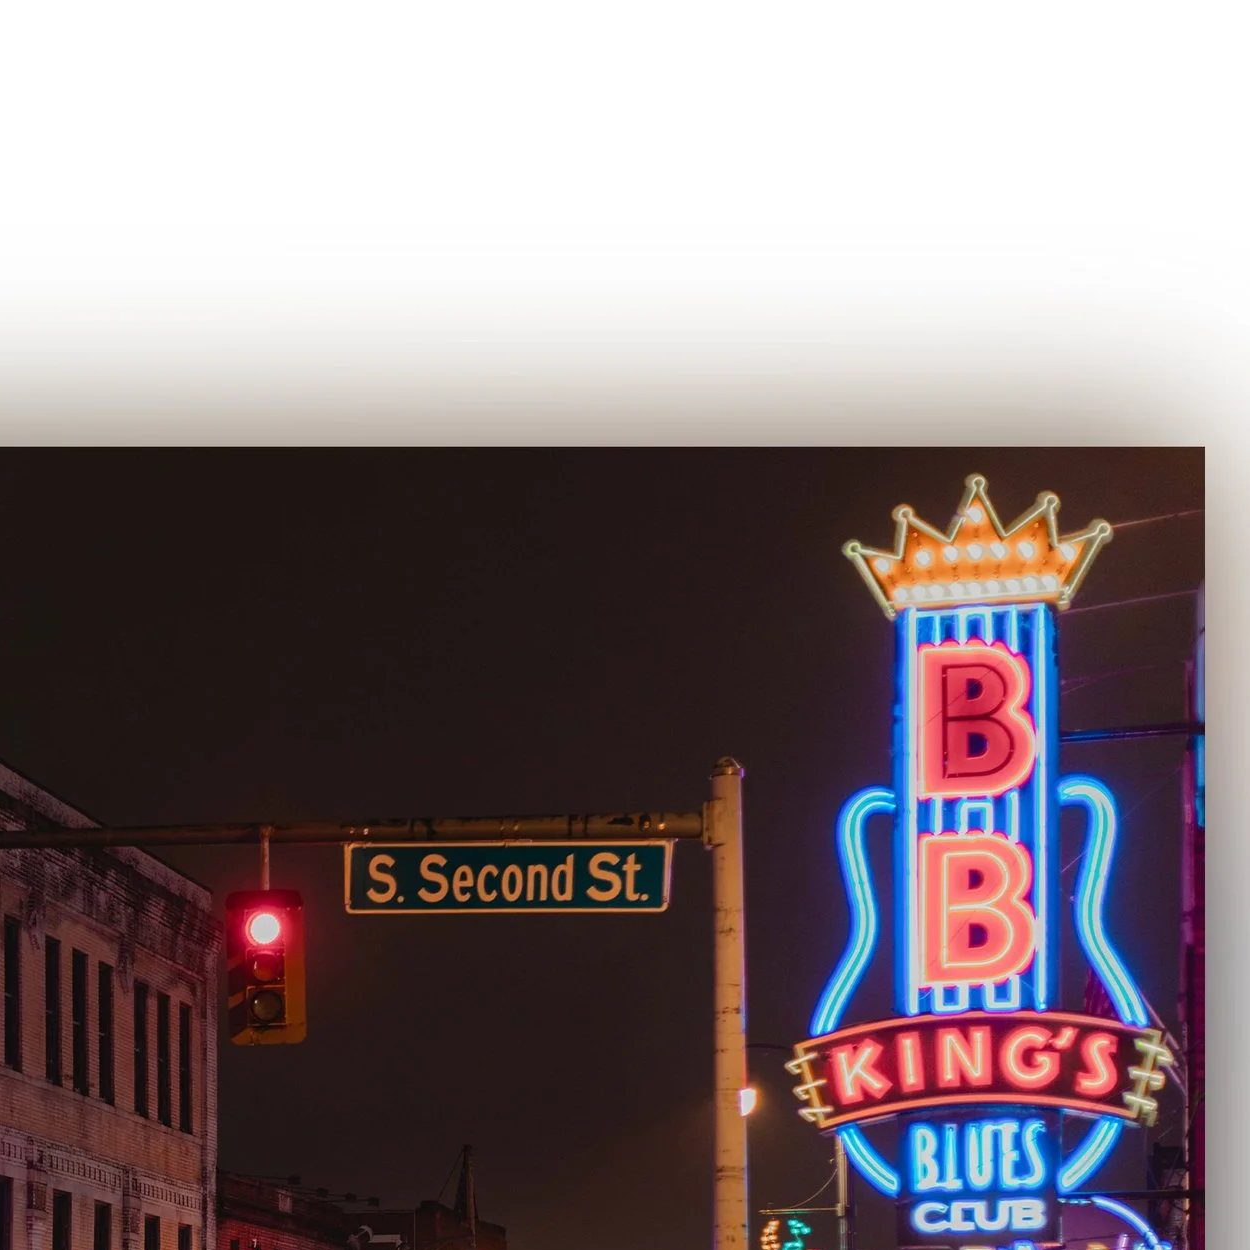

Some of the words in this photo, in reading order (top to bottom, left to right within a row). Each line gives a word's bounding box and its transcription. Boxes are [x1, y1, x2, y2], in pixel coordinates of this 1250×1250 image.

[918, 640, 1037, 800] B
[366, 853, 405, 903] S.
[417, 852, 575, 903] Second
[585, 852, 650, 902] St.
[918, 835, 1037, 989] B
[830, 1025, 1118, 1105] KING'S
[911, 1119, 1047, 1192] BLUES
[912, 1200, 1047, 1232] CLUB
